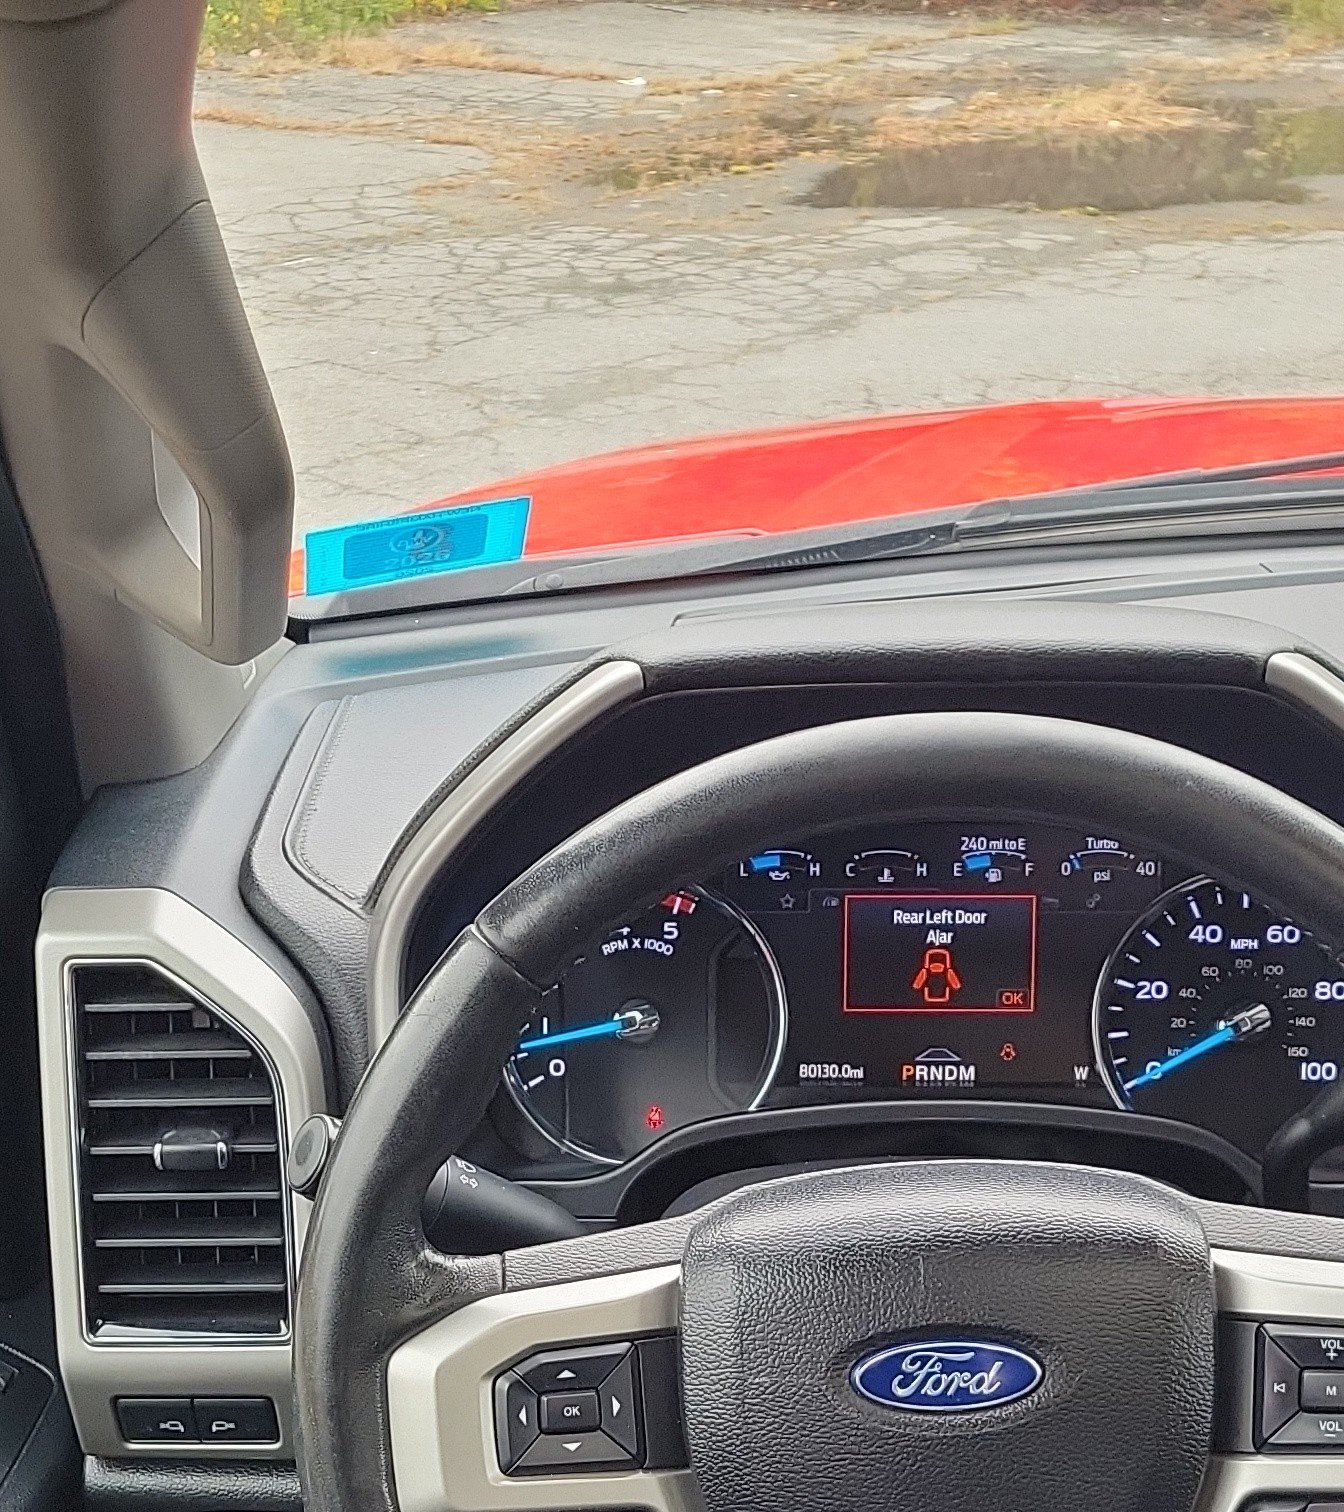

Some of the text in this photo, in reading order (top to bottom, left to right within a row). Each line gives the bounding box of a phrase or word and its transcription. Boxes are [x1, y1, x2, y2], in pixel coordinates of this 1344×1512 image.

[960, 837, 1026, 851] 240 mi to E
[1086, 837, 1119, 851] Turbo
[739, 862, 749, 878] L
[809, 862, 821, 878] H
[845, 862, 856, 878] C
[916, 862, 928, 878] H
[953, 863, 963, 877] E
[1025, 863, 1034, 877] F
[1060, 862, 1071, 877] 0
[1094, 868, 1111, 883] psi
[1136, 862, 1156, 877] 40
[893, 909, 988, 926] Rear Left Door
[663, 921, 679, 940] 5
[926, 928, 954, 946] Ajar
[1189, 924, 1223, 945] 40
[1266, 924, 1301, 945] 60
[601, 937, 674, 956] RPM X 1000
[1230, 938, 1259, 951] MPH
[1201, 965, 1219, 978] 60
[1235, 958, 1253, 970] 80
[1263, 964, 1284, 976] 100
[1136, 980, 1169, 1001] 20
[1178, 987, 1197, 999] 40
[1288, 987, 1308, 998] 120
[1002, 991, 1024, 1006] OK
[1170, 1017, 1187, 1029] 20
[1295, 1016, 1316, 1028] 140
[548, 1058, 567, 1077] 0
[901, 1064, 976, 1082] PRNDM
[1073, 1065, 1090, 1081] W
[1299, 1061, 1338, 1082] 100
[1320, 1339, 1344, 1351] VOL
[891, 1351, 1005, 1398] Ford
[1325, 1385, 1338, 1396] M
[562, 1405, 582, 1417] OK
[1318, 1420, 1344, 1432] VOL
